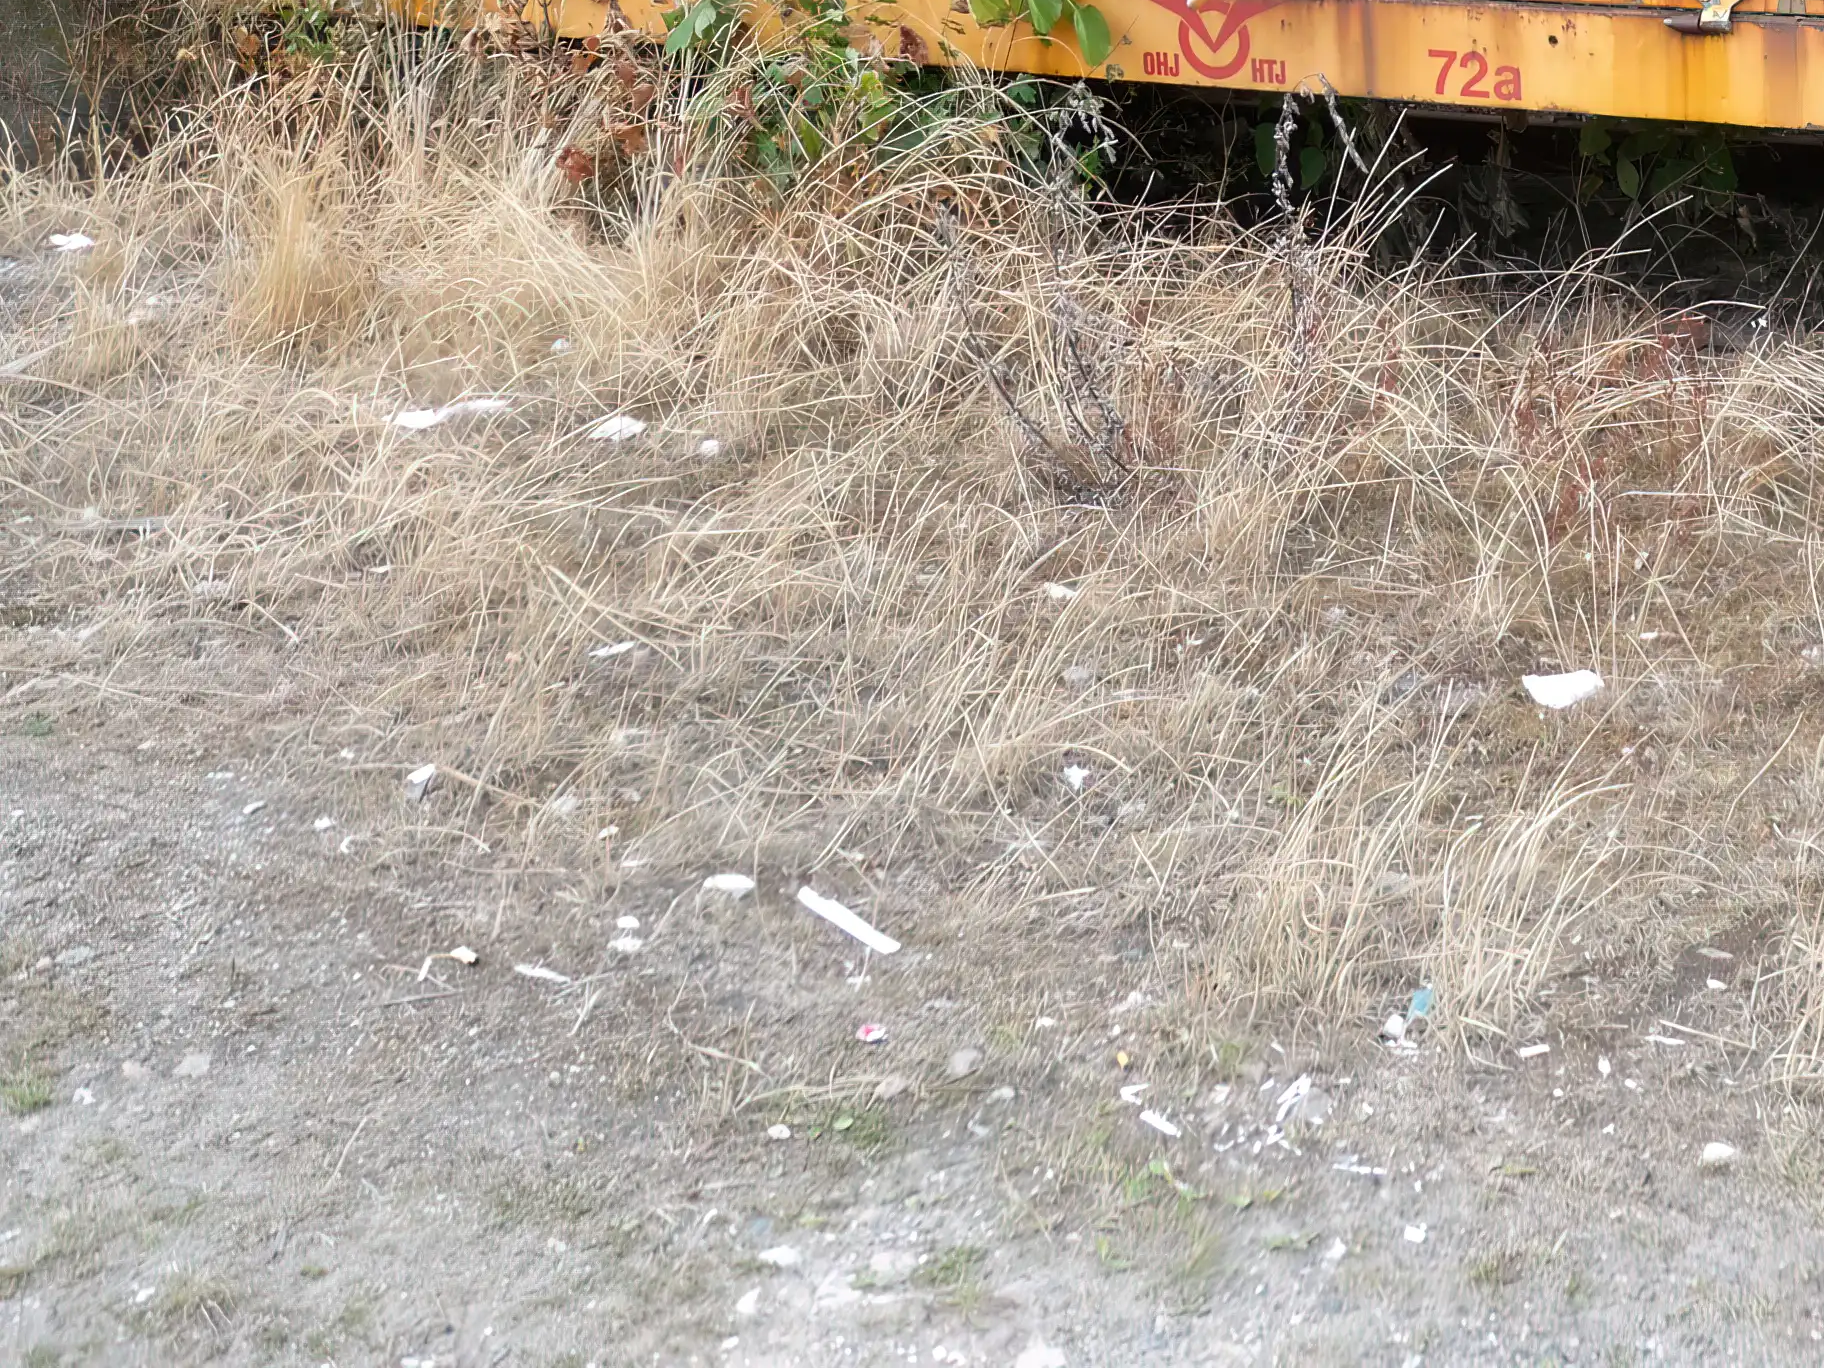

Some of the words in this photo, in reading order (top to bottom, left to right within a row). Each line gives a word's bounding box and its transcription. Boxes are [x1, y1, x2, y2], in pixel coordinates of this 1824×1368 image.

[1142, 51, 1180, 77] OHJ
[1251, 58, 1287, 85] HTJ
[1427, 48, 1522, 101] 72a
